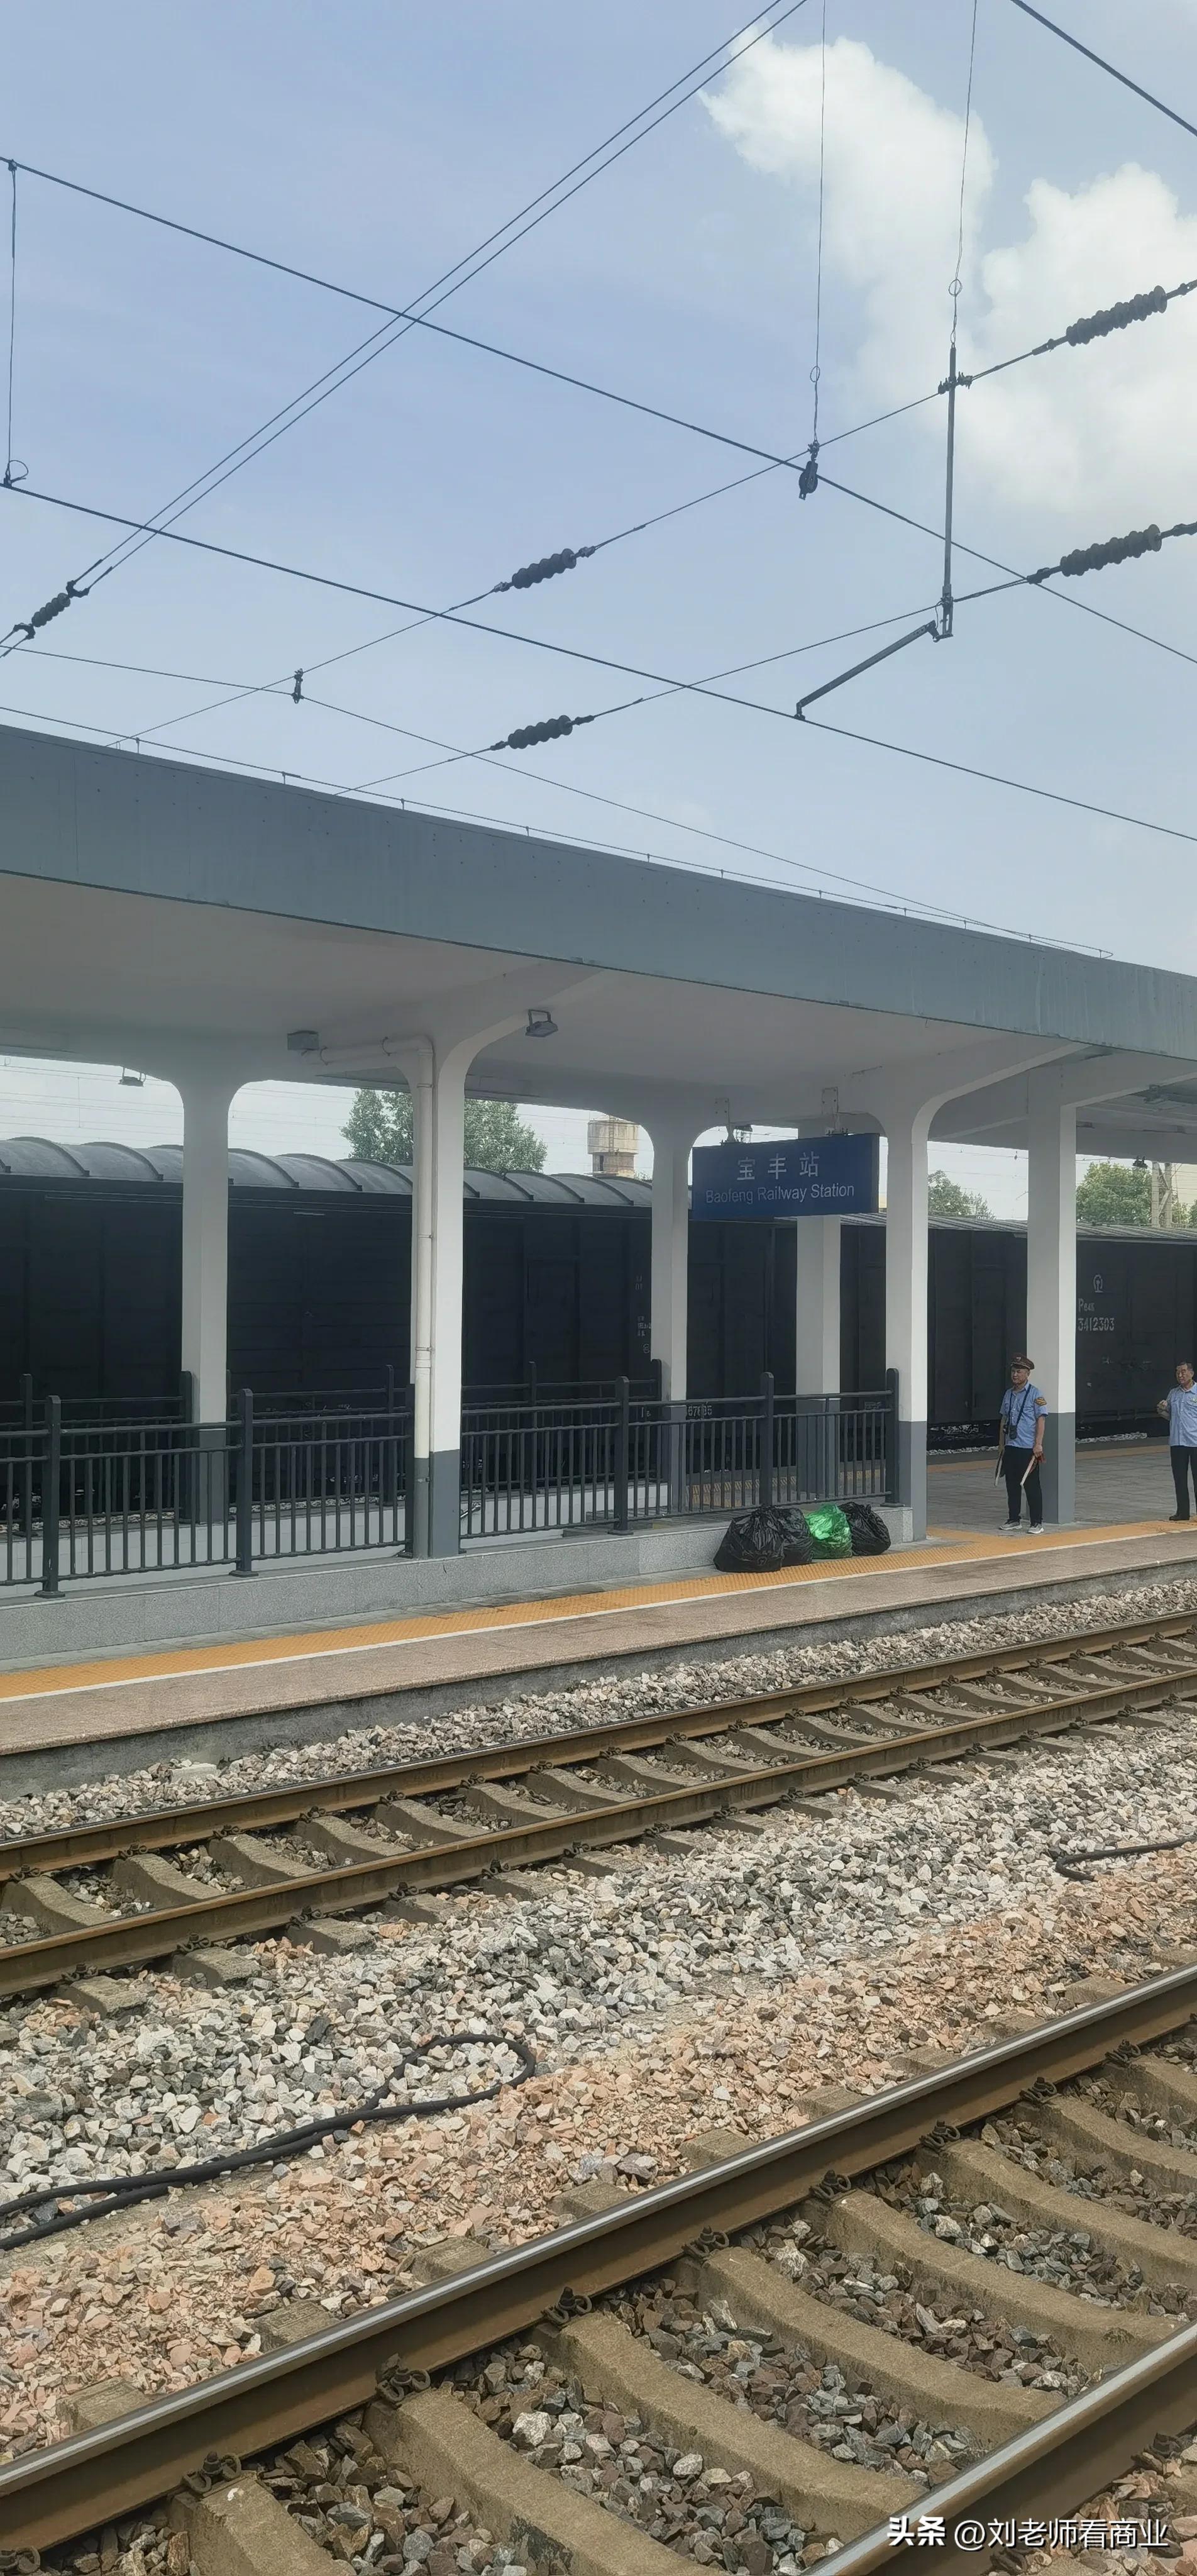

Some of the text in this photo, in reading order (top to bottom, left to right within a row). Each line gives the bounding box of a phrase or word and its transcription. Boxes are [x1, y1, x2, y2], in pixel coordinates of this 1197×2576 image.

[737, 1151, 820, 1180] 宝丰站
[706, 1183, 854, 1204] Baofeng Railway Station
[1078, 1318, 1115, 1331] 3412303
